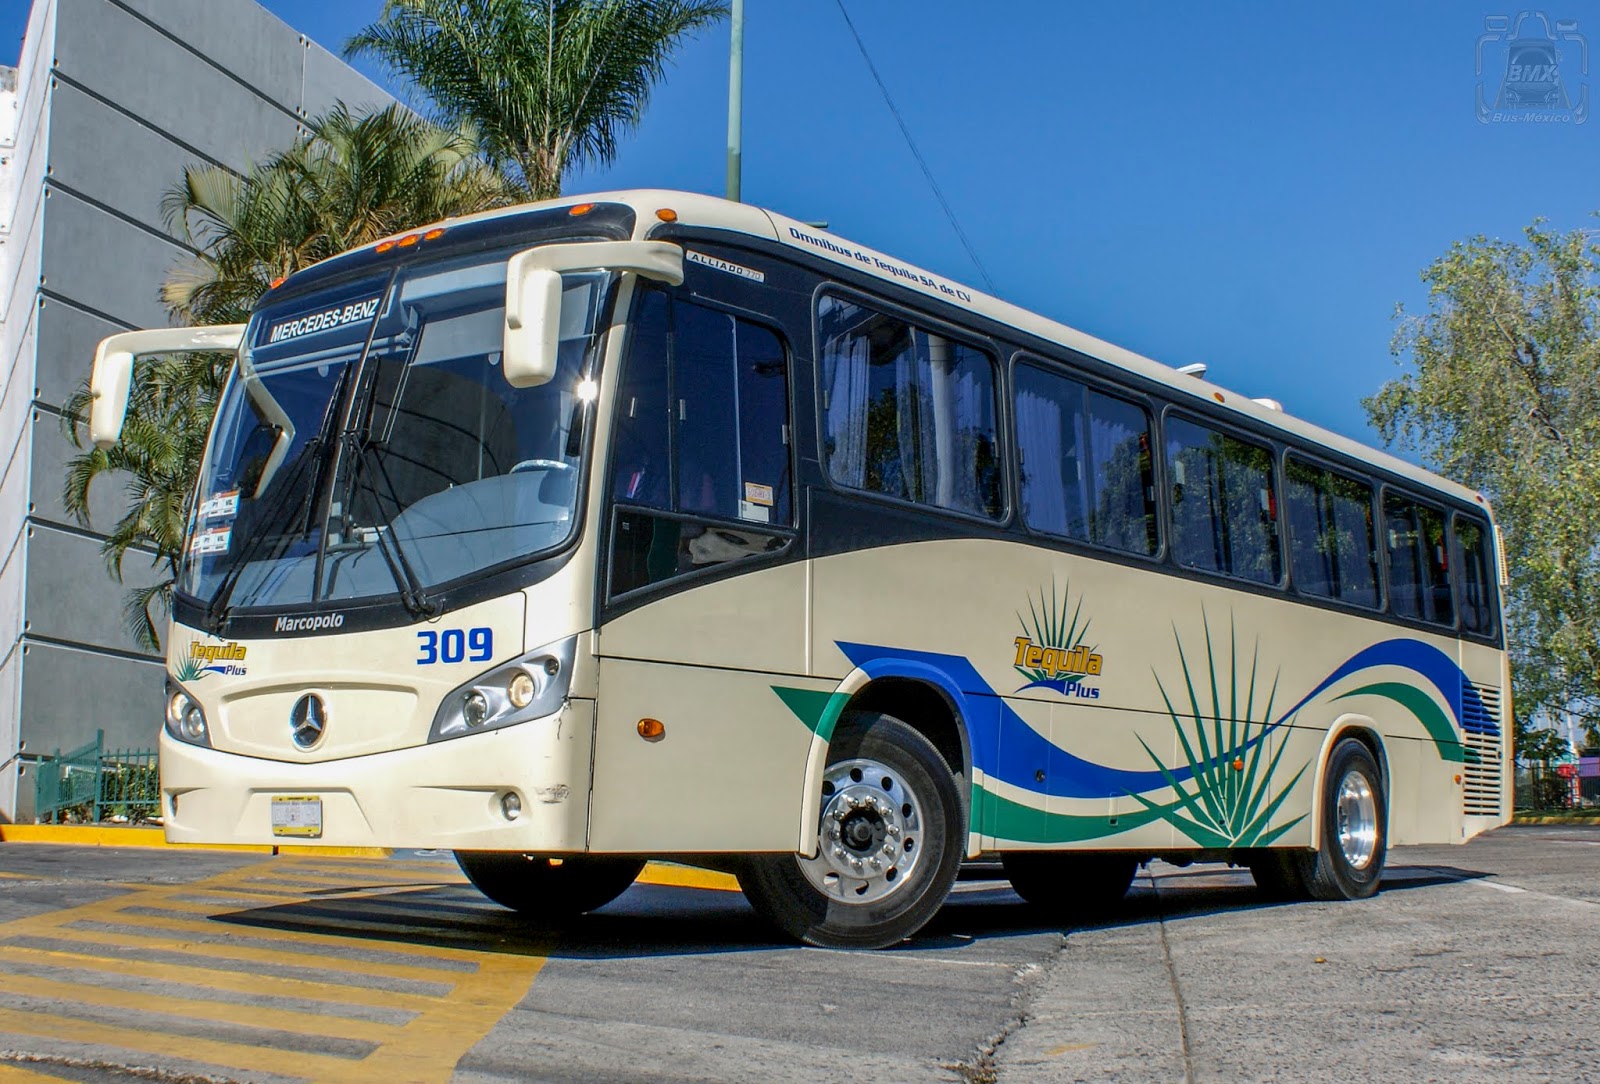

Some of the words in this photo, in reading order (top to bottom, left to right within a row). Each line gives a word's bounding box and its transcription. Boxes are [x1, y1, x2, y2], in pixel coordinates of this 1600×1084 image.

[691, 253, 743, 275] ALLIADO
[789, 227, 852, 258] Omnibus
[854, 251, 872, 265] de
[871, 256, 919, 282] Tequila
[919, 275, 938, 290] SA
[939, 284, 956, 297] de
[956, 289, 971, 302] CV
[270, 298, 380, 343] MERCEDES-BENZ
[274, 612, 344, 632] Marcopolo
[190, 641, 247, 664] Tequila
[416, 627, 493, 665] 309
[1014, 636, 1103, 677] Tequila
[225, 665, 247, 676] Plus
[1064, 680, 1100, 699] Plus
